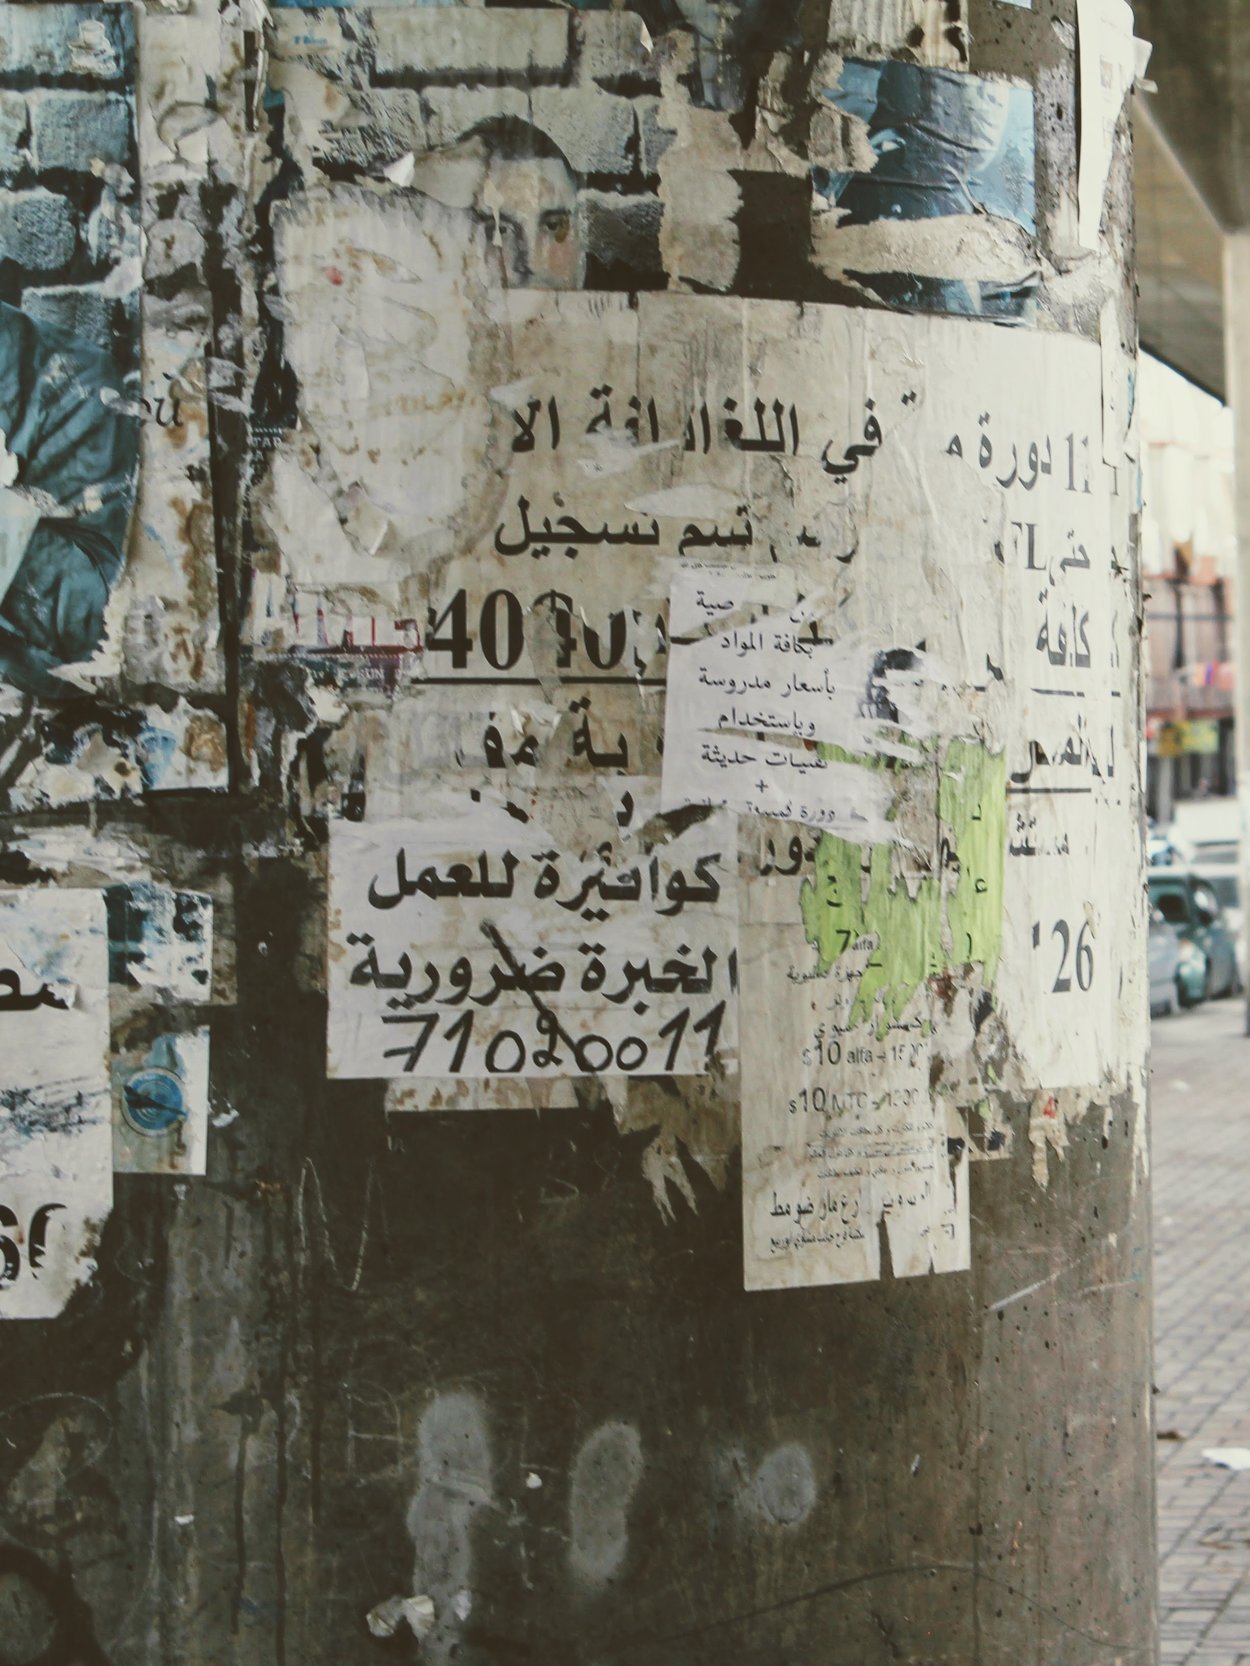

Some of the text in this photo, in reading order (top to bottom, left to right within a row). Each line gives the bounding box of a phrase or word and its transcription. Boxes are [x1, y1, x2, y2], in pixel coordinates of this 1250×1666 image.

[822, 398, 882, 484] في
[720, 631, 763, 657] المواد
[698, 667, 772, 695] مدروسة
[701, 744, 756, 768] حديثة
[368, 848, 520, 910] للعمل
[347, 932, 739, 1017] الخبرة ضرورية
